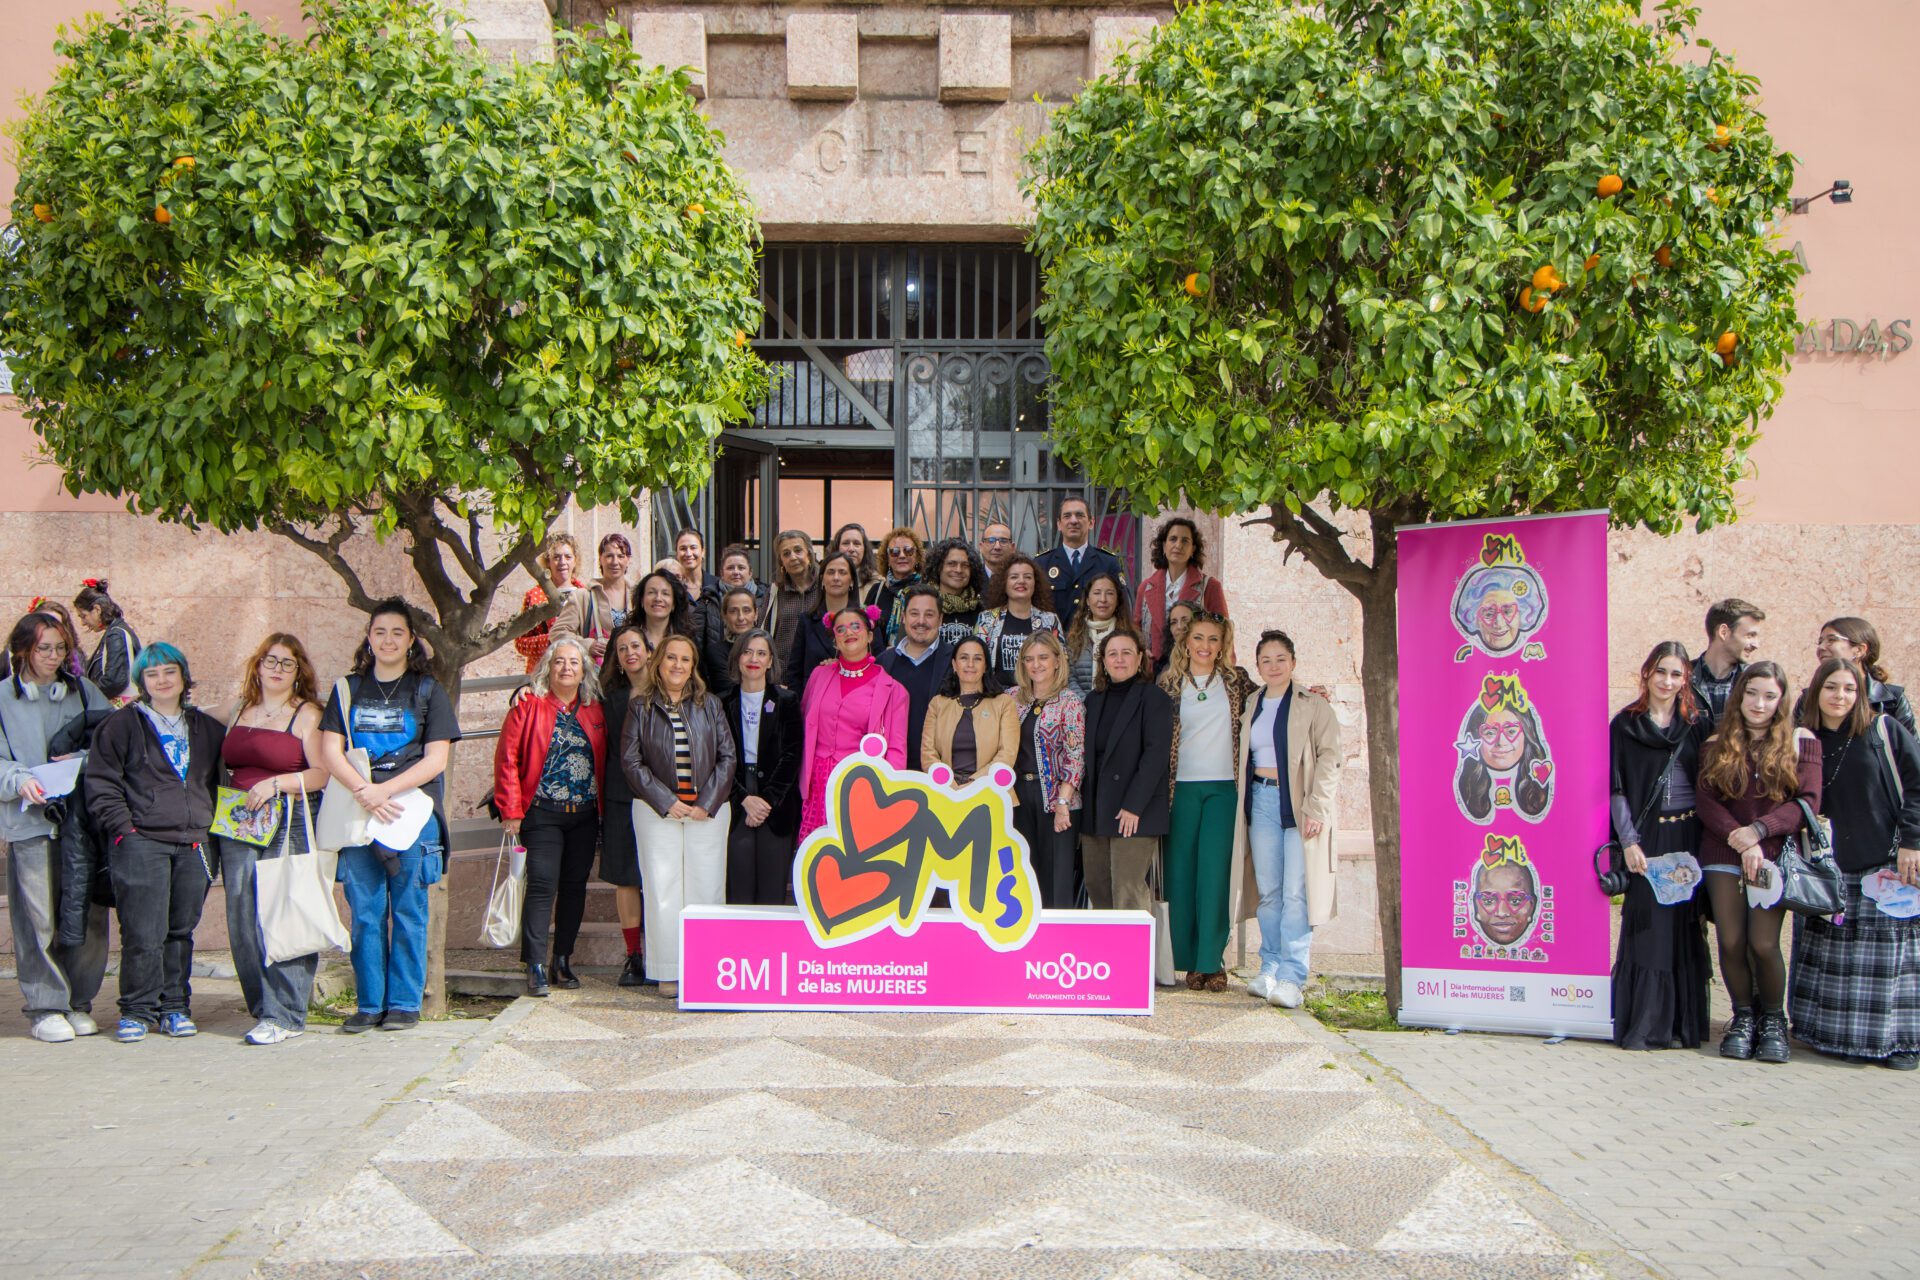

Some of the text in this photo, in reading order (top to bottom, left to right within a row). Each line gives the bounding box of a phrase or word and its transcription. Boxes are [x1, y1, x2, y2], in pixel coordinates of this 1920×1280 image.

[815, 129, 988, 178] CHILE
[716, 957, 770, 991] 8M
[798, 960, 928, 977] Día Internacional
[798, 979, 927, 995] de las MUJERES
[1417, 981, 1440, 996] 8M
[1462, 984, 1505, 992] Internacional
[1471, 992, 1505, 1000] MUJERES
